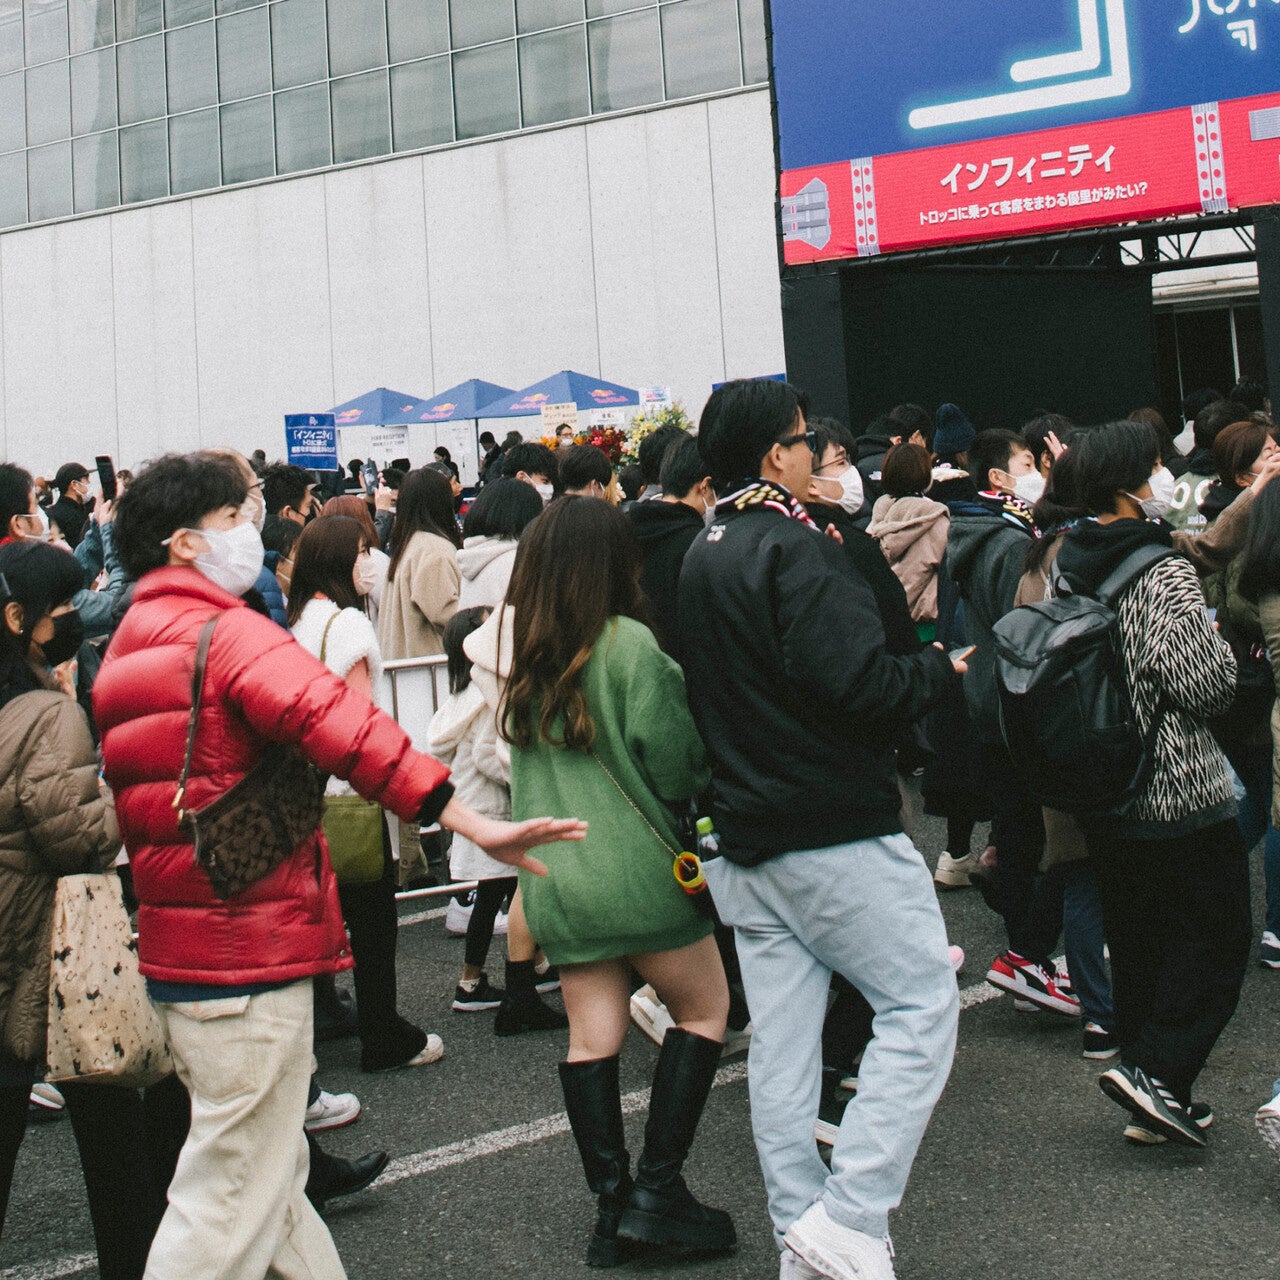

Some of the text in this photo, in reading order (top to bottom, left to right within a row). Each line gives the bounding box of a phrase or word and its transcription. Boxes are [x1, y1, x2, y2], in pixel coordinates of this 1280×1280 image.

[939, 143, 1116, 195] インフィニティ
